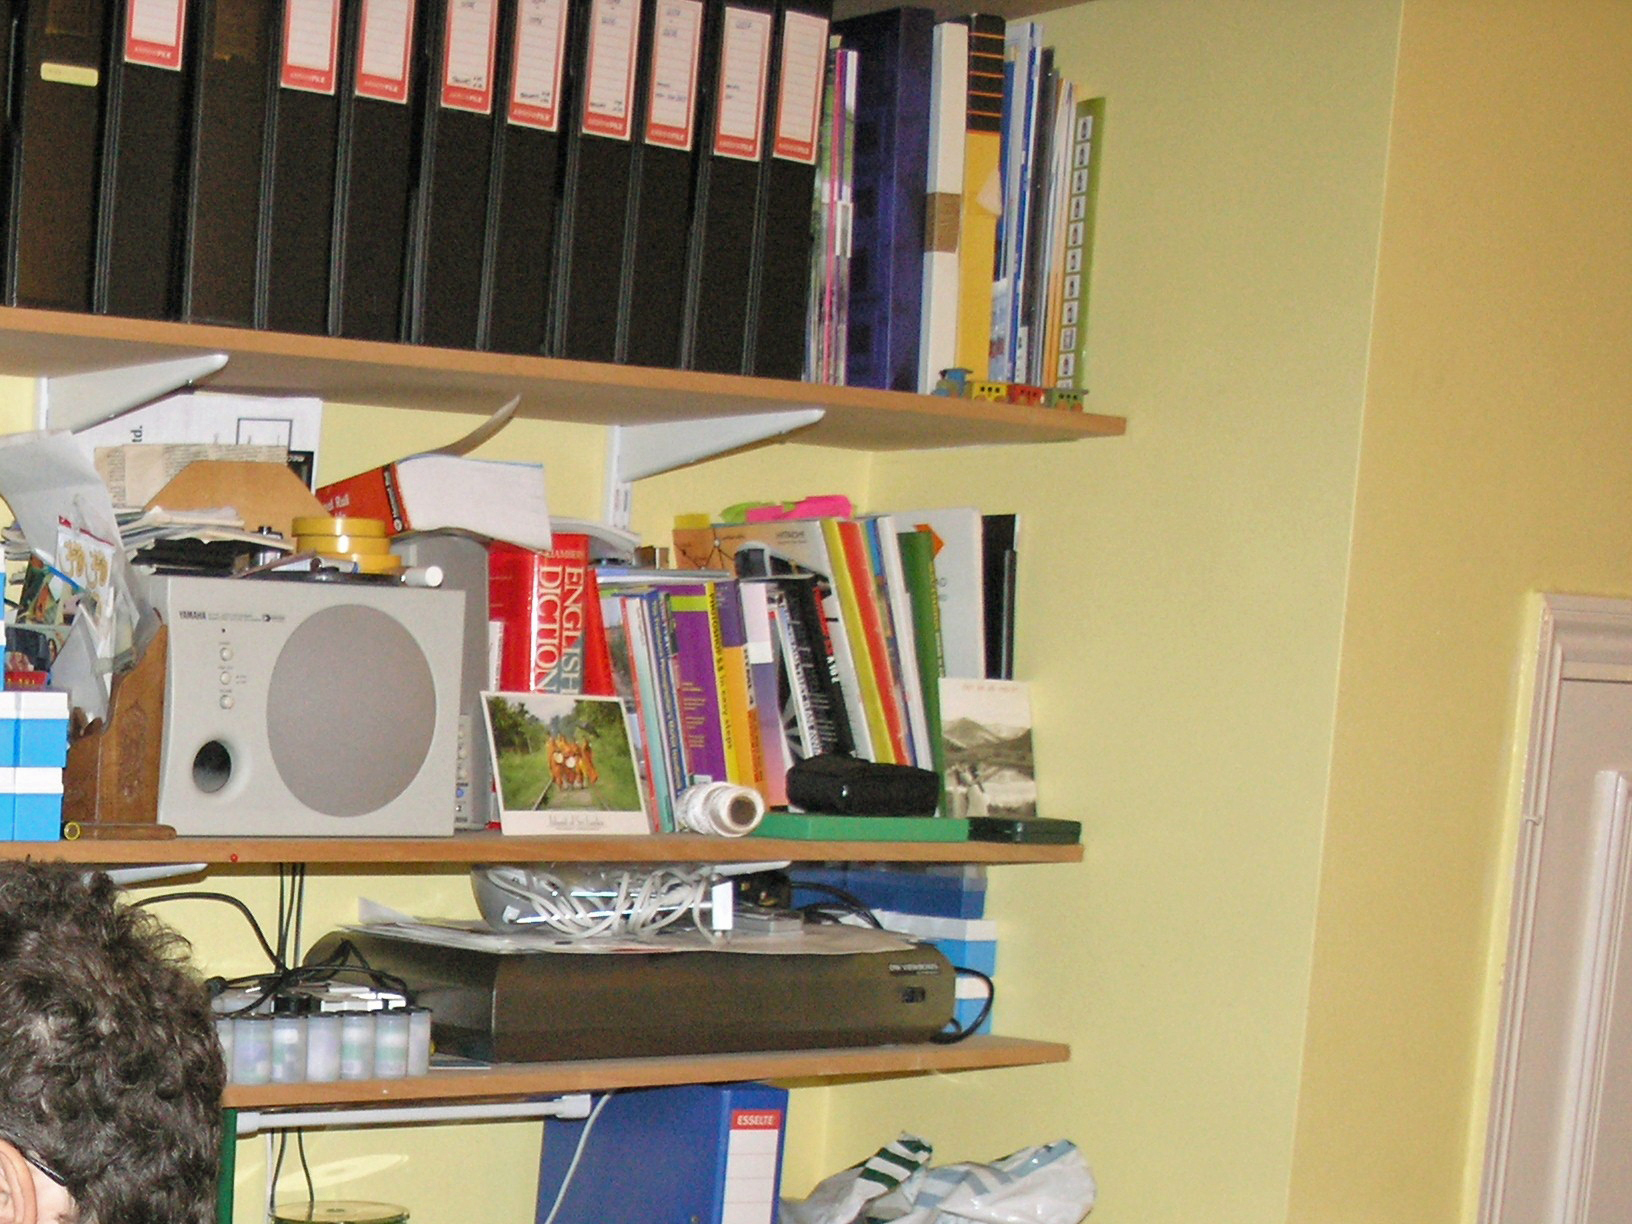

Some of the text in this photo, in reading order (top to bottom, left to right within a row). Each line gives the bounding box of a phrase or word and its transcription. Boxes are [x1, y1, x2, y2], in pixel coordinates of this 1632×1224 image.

[178, 610, 207, 620] YAMAHA
[534, 566, 563, 695] DICTION
[560, 566, 585, 694] ENGLISH
[735, 1114, 775, 1127] ESSELTE
